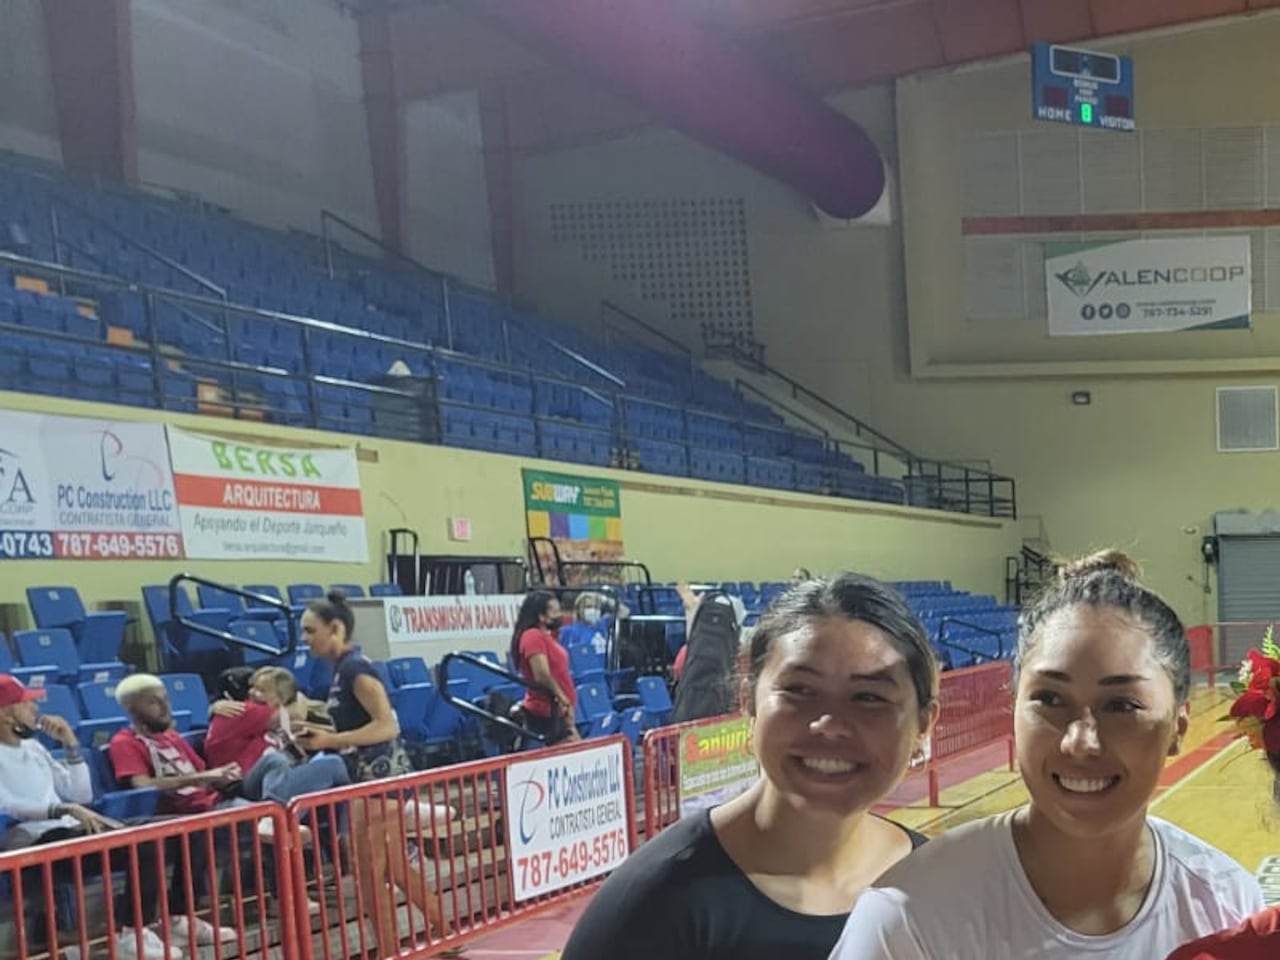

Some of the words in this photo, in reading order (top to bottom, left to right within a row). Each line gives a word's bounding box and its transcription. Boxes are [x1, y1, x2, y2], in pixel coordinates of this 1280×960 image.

[1038, 106, 1072, 121] HOME
[1099, 115, 1135, 130] VISITOR
[211, 440, 322, 478] BERSA
[57, 484, 74, 508] PC
[77, 486, 146, 511] Construction
[148, 490, 172, 511] LLC
[223, 483, 321, 511] ARQUITECTURA
[530, 481, 580, 505] SUBWAY
[59, 511, 126, 526] CONTRATISTA
[193, 512, 247, 535] Apoyando
[250, 516, 260, 532] el
[263, 516, 302, 537] Deporte
[58, 533, 178, 558] 787-649-5576
[474, 603, 509, 630] RADIAL
[547, 767, 561, 811] PC
[563, 759, 608, 808] Construction
[608, 752, 620, 793] LLC
[550, 807, 597, 840] CONTRATISTA
[597, 801, 623, 828] GENERAL
[517, 828, 626, 891] 787-649-5576
